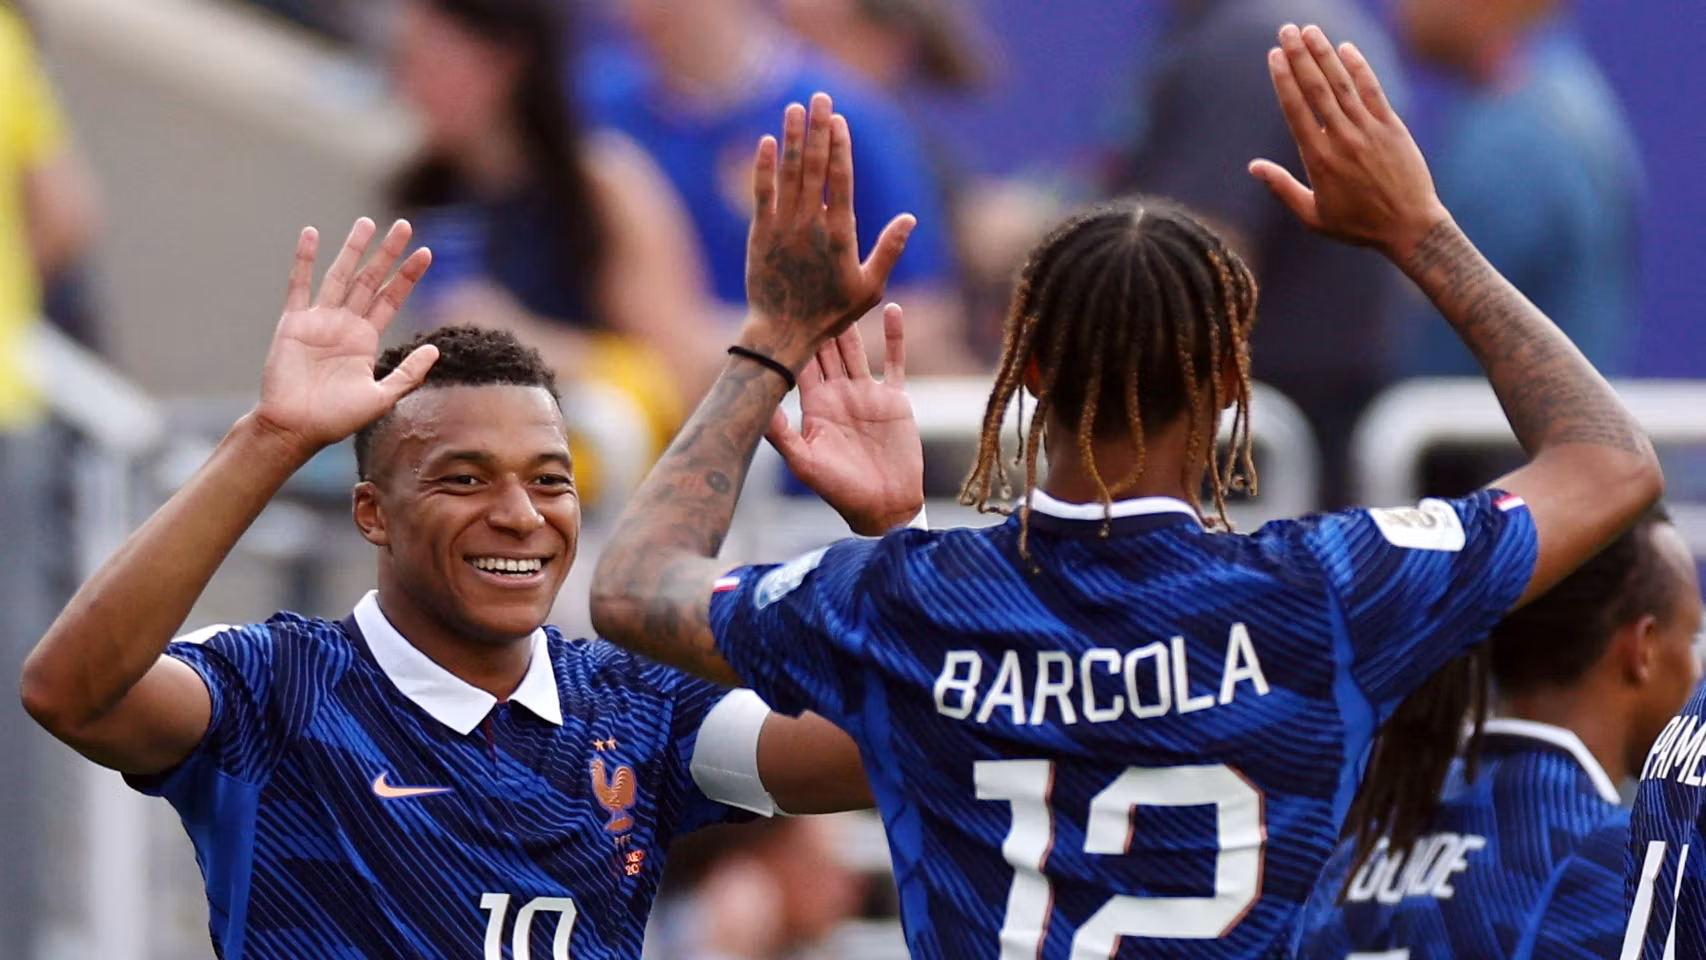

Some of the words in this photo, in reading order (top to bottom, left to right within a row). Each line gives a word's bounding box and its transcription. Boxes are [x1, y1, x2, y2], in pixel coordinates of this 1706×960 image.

[933, 622, 1270, 725] BARCOLA
[1640, 715, 1706, 787] PAME
[974, 759, 1267, 960] 12
[1346, 833, 1487, 904] OUNDE
